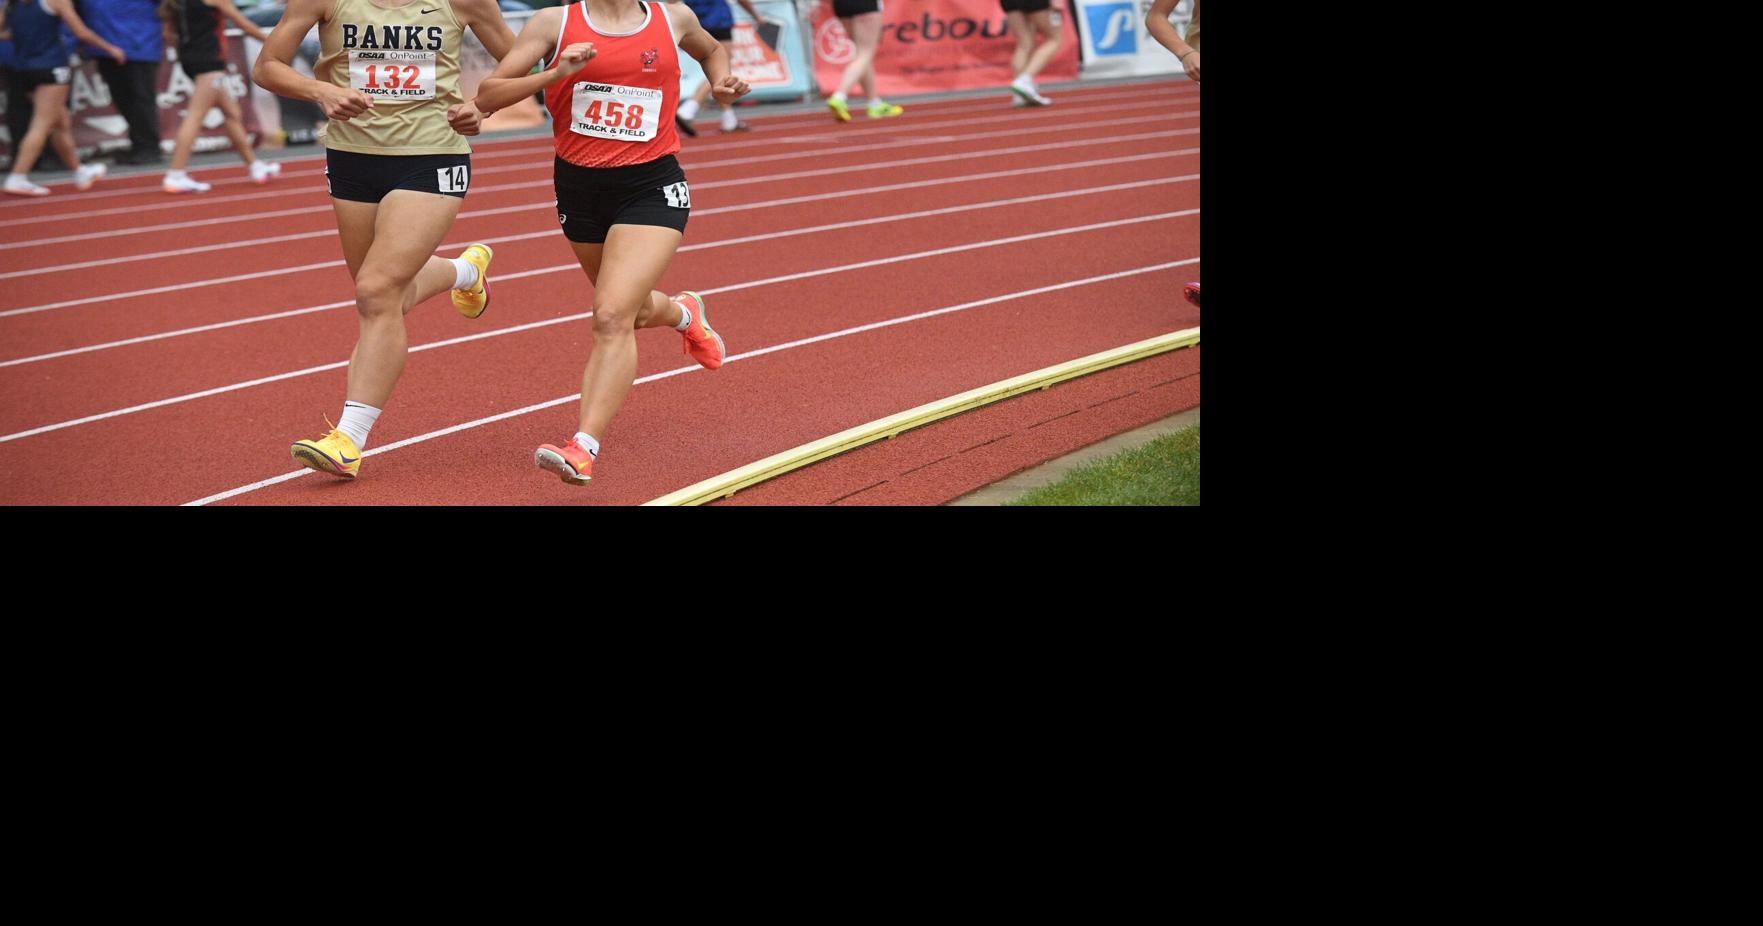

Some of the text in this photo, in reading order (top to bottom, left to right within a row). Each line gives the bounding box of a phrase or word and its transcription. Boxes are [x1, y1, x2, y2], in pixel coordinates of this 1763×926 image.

[343, 24, 443, 50] BANKS
[358, 52, 427, 60] OSAA OnPoint
[366, 64, 420, 89] 132
[584, 84, 654, 97] OSAA OnPoint
[585, 100, 644, 129] 458
[578, 123, 607, 133] TRACK
[619, 129, 645, 137] FIELD
[445, 167, 465, 190] 14
[671, 183, 689, 207] 13
